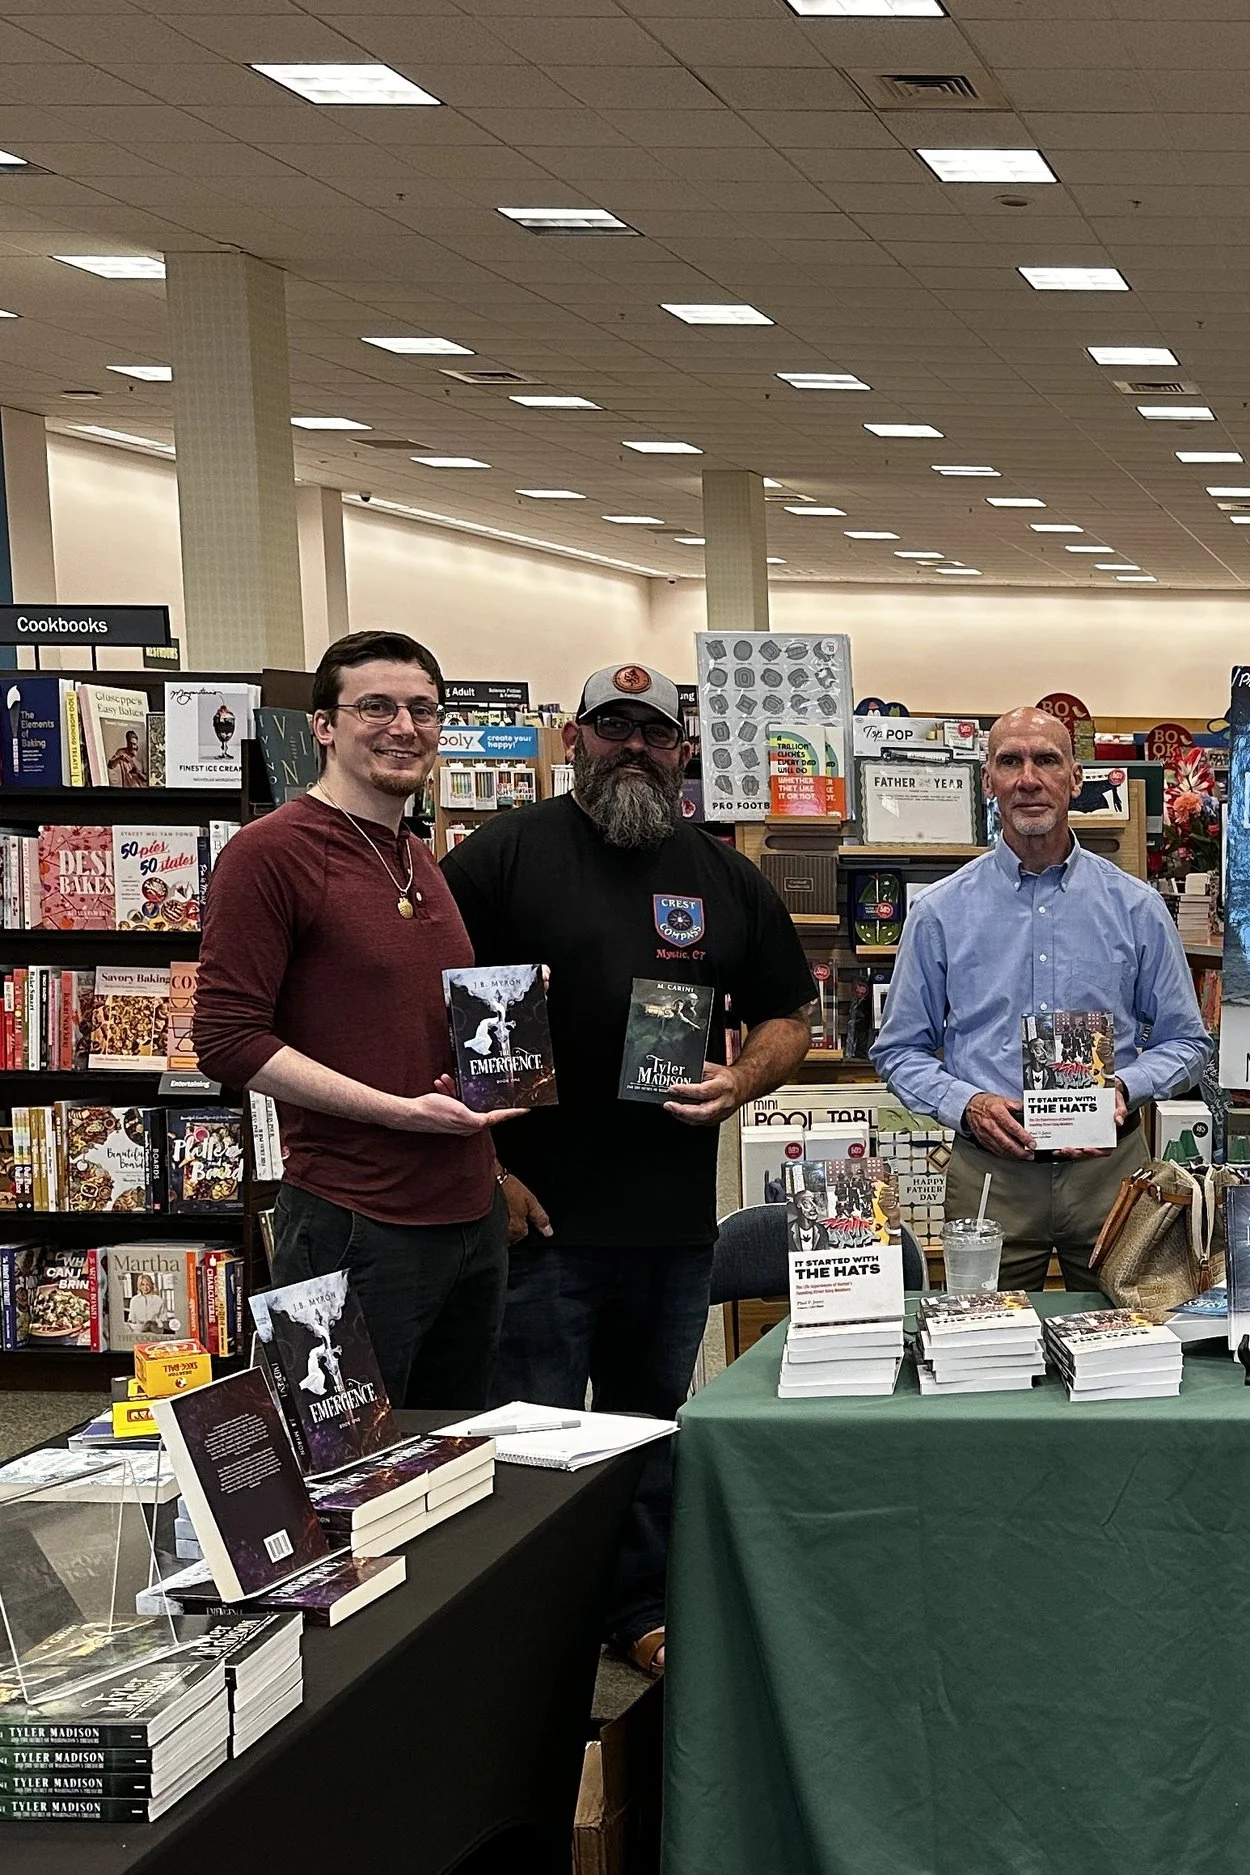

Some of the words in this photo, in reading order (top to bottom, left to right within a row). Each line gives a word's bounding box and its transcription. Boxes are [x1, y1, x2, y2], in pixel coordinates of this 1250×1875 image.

[16, 616, 108, 634] Cookbooks
[452, 687, 476, 697] Adult
[21, 711, 35, 720] The
[97, 703, 116, 716] Easy
[22, 731, 29, 739] of
[863, 725, 883, 742] Top
[886, 729, 914, 740] POP
[22, 740, 46, 748] Baking
[487, 741, 516, 749] happy!
[514, 736, 532, 744] your
[874, 776, 916, 788] FATHER
[933, 778, 963, 789] YEAR
[120, 841, 138, 860] 50
[136, 841, 170, 859] pies
[58, 850, 114, 876] DESI
[139, 857, 158, 877] 50
[156, 853, 197, 873] states
[59, 875, 115, 895] BAKES
[661, 898, 696, 910] CREST
[660, 923, 702, 941] COMPASS
[101, 972, 134, 984] Savory
[136, 972, 170, 984] Baking
[490, 979, 522, 987] MYRON
[667, 984, 694, 992] CARINI
[469, 1053, 543, 1076] EMERGENCE
[645, 1054, 686, 1076] Tyler
[637, 1067, 692, 1085] MADISON
[170, 1080, 210, 1089] Entertaining
[753, 1099, 778, 1110] mini
[1028, 1104, 1056, 1114] THE
[1059, 1103, 1098, 1113] HATS
[827, 1110, 878, 1128] TABL
[913, 1178, 945, 1186] HAPPY
[906, 1186, 945, 1194] FATHER'
[114, 1255, 180, 1272] Martha
[806, 1257, 851, 1267] STARTED
[852, 1255, 879, 1263] WITH
[47, 1268, 73, 1278] CAN
[795, 1267, 831, 1280] THE
[834, 1264, 881, 1277] HATS
[59, 1280, 89, 1290] BRIN
[206, 1268, 216, 1323] CHARCUTERIE
[309, 1291, 337, 1306] MYRON
[309, 1382, 378, 1424] EMERGENCE
[9, 1727, 45, 1737] TYLER
[50, 1727, 99, 1737] MADISON
[14, 1752, 50, 1762] TYLER
[55, 1752, 104, 1762] MADISON
[13, 1778, 49, 1788] TYLER
[54, 1778, 103, 1788] MADISON
[12, 1802, 47, 1812] TYLER
[52, 1802, 101, 1812] MADISON
